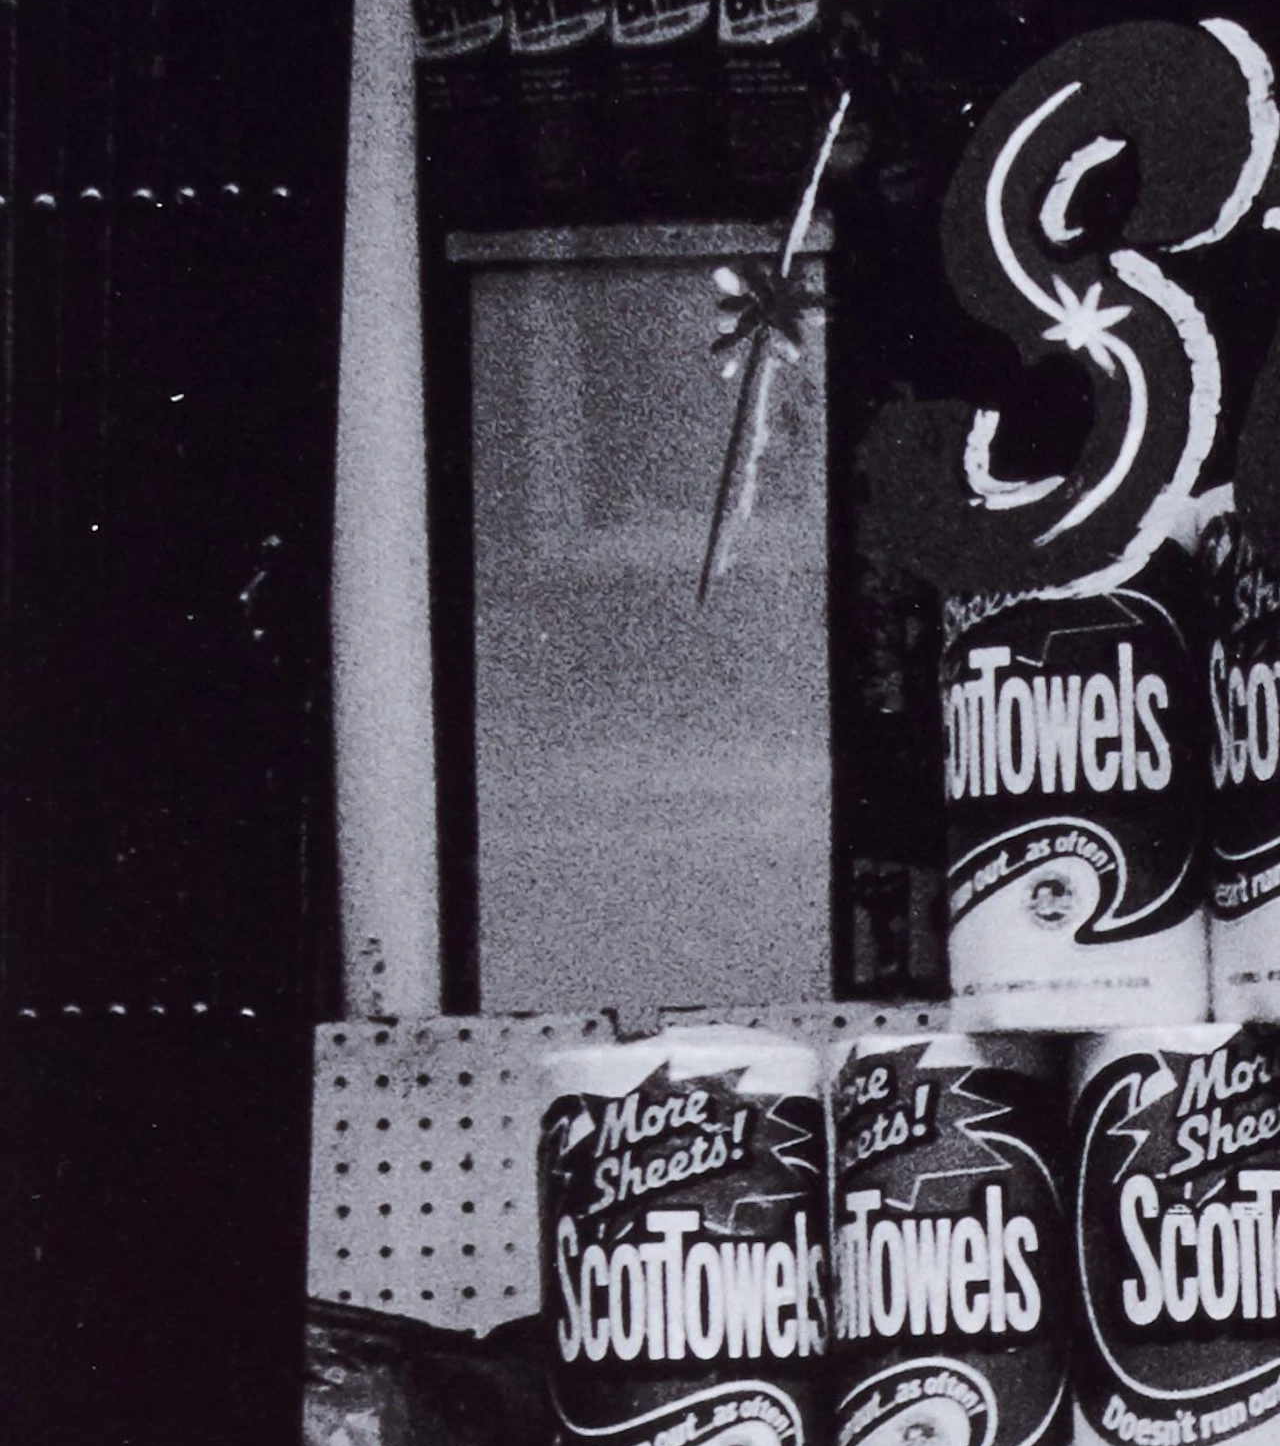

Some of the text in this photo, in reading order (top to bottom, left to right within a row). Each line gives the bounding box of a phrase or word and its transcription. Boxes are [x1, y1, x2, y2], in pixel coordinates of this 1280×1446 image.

[594, 1089, 710, 1158] More
[588, 1109, 748, 1216] Sheets!
[1199, 1401, 1248, 1440] run
